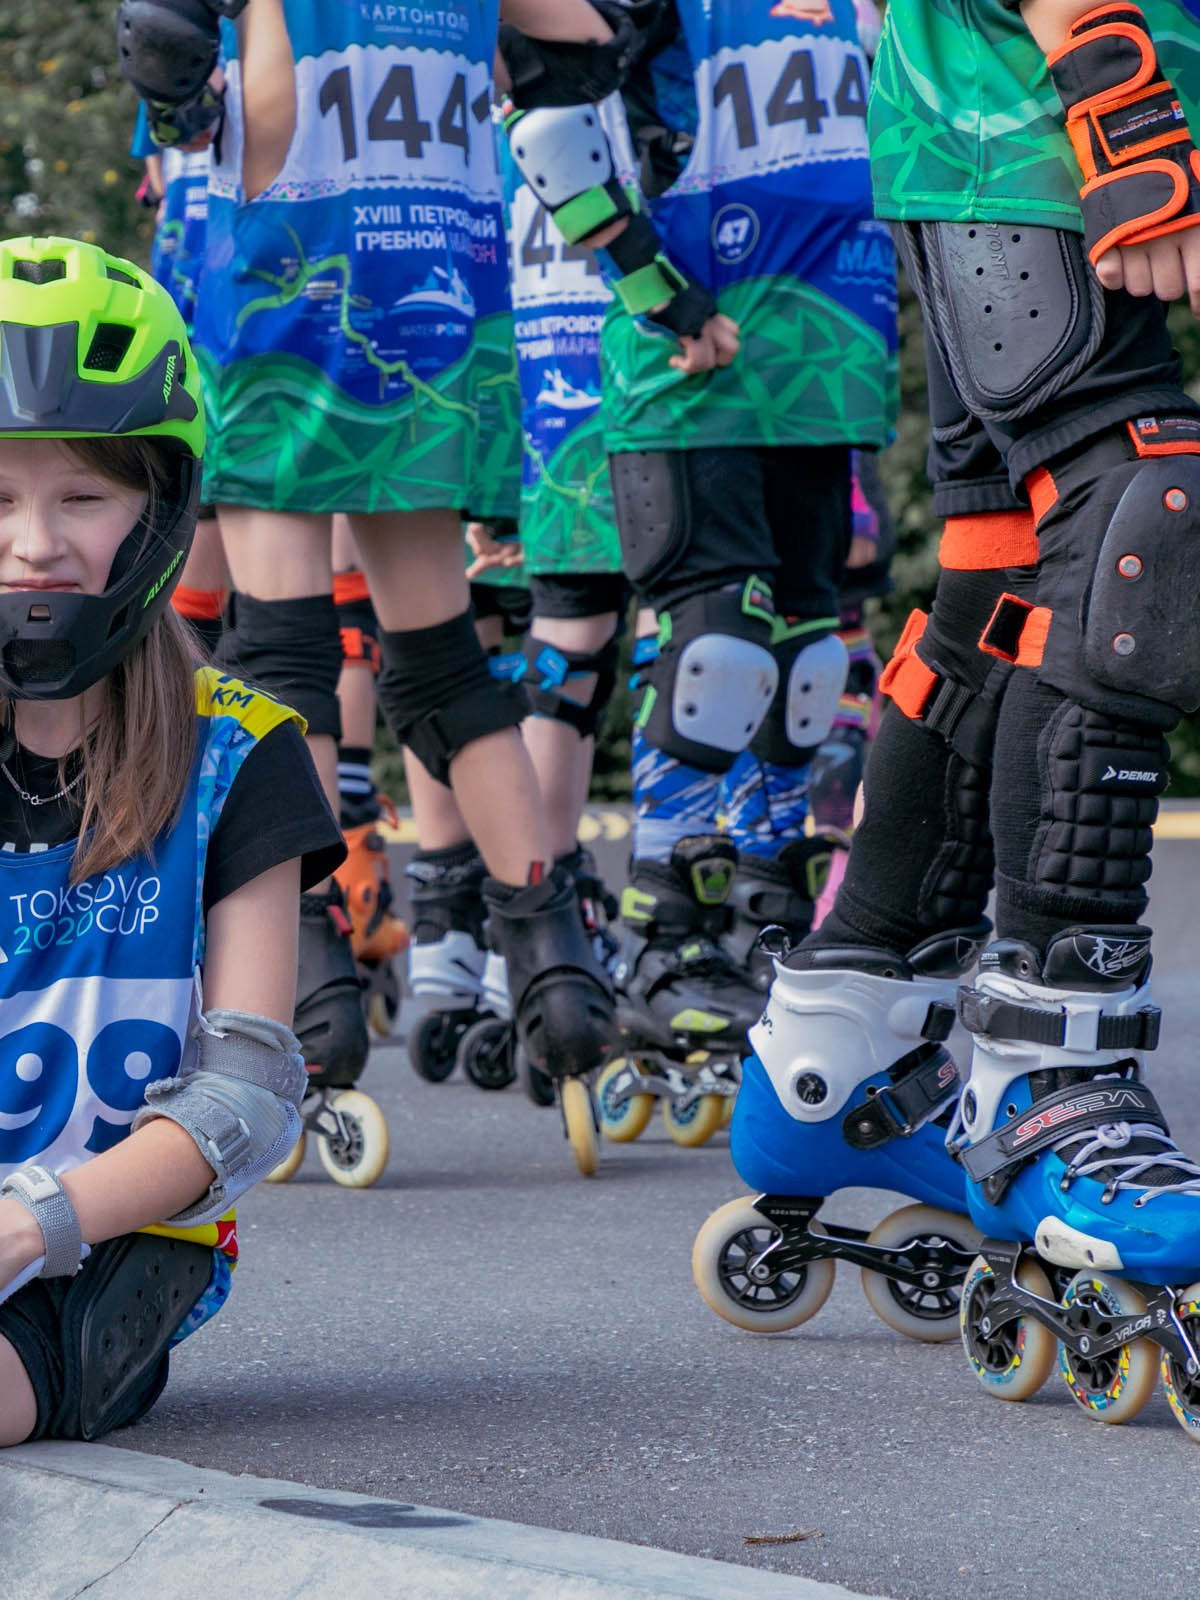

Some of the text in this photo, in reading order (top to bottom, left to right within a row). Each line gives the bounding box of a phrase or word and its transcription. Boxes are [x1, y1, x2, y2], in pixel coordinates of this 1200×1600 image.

[354, 205, 402, 226] XVIII
[355, 227, 448, 251] ГРЕБНОЙ
[163, 354, 177, 405] ALPINA
[143, 550, 185, 609] ALPINA
[210, 687, 256, 708] KM
[1116, 769, 1160, 783] DEMIX
[9, 874, 161, 924] TOKSOVO
[1012, 1090, 1146, 1147] SEBA
[1114, 1314, 1152, 1341] VALOR
